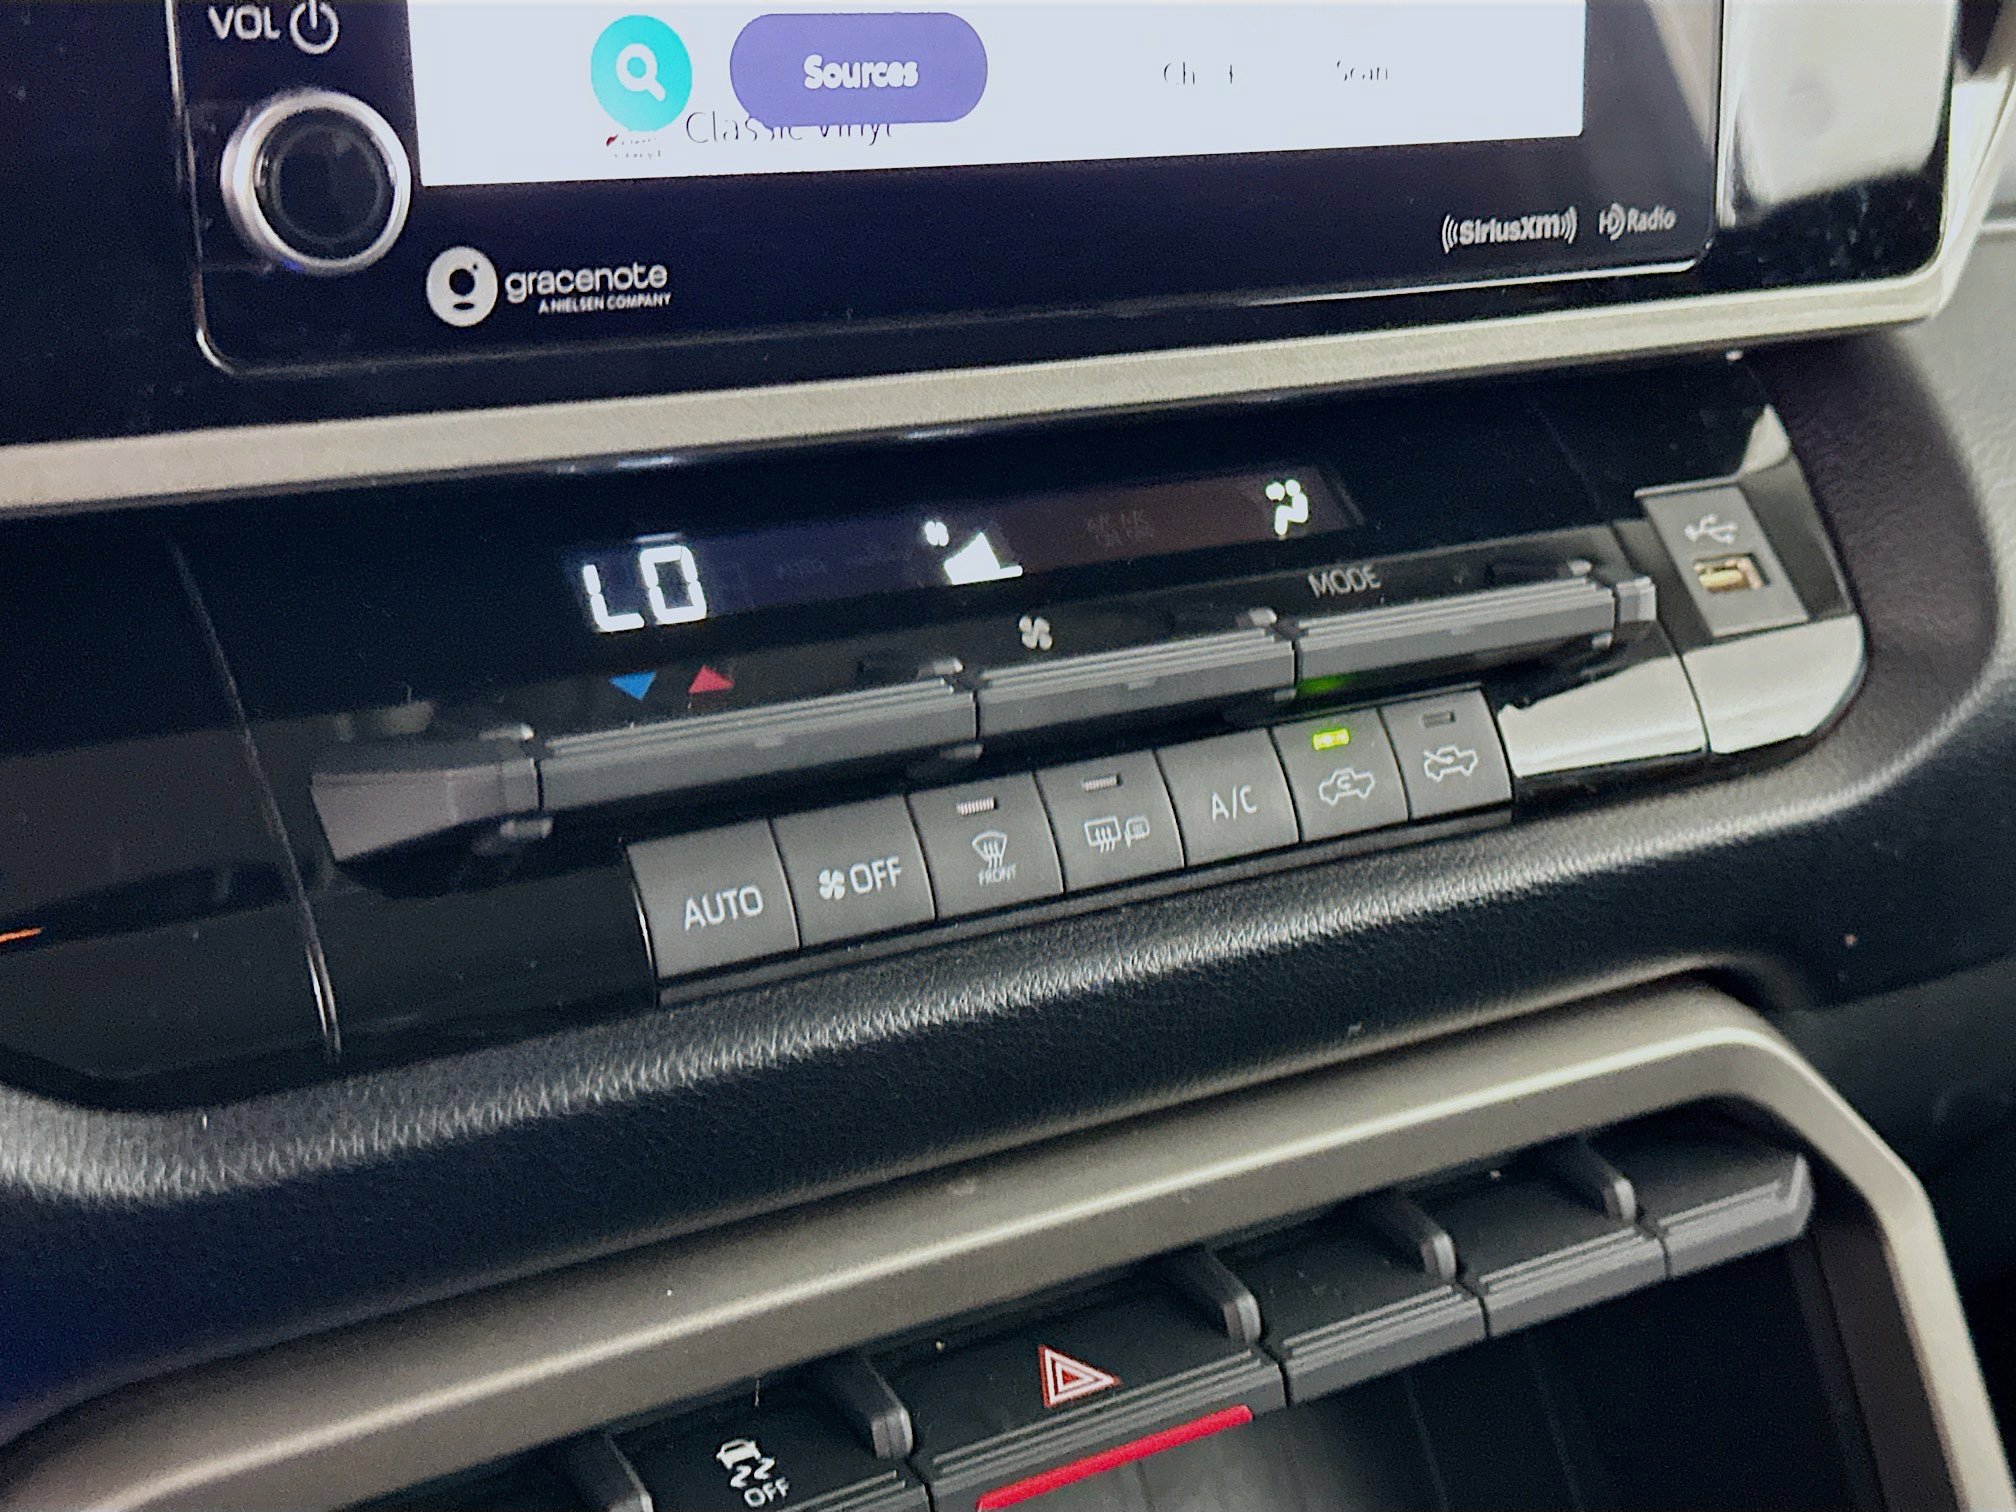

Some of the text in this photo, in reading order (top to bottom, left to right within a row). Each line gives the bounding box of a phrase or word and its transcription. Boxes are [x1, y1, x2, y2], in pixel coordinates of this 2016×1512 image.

[208, 5, 281, 40] VOL
[803, 54, 919, 89] Sources
[1627, 205, 1677, 233] Radio
[504, 262, 668, 304] gracenote
[538, 291, 672, 315] A NIELSEN COMPANY
[1308, 565, 1382, 599] MODE
[1211, 784, 1258, 822] A/C
[849, 856, 902, 895] OFF
[978, 862, 1017, 887] FRONT
[684, 886, 764, 931] AUTO
[744, 1477, 790, 1507] OFF
